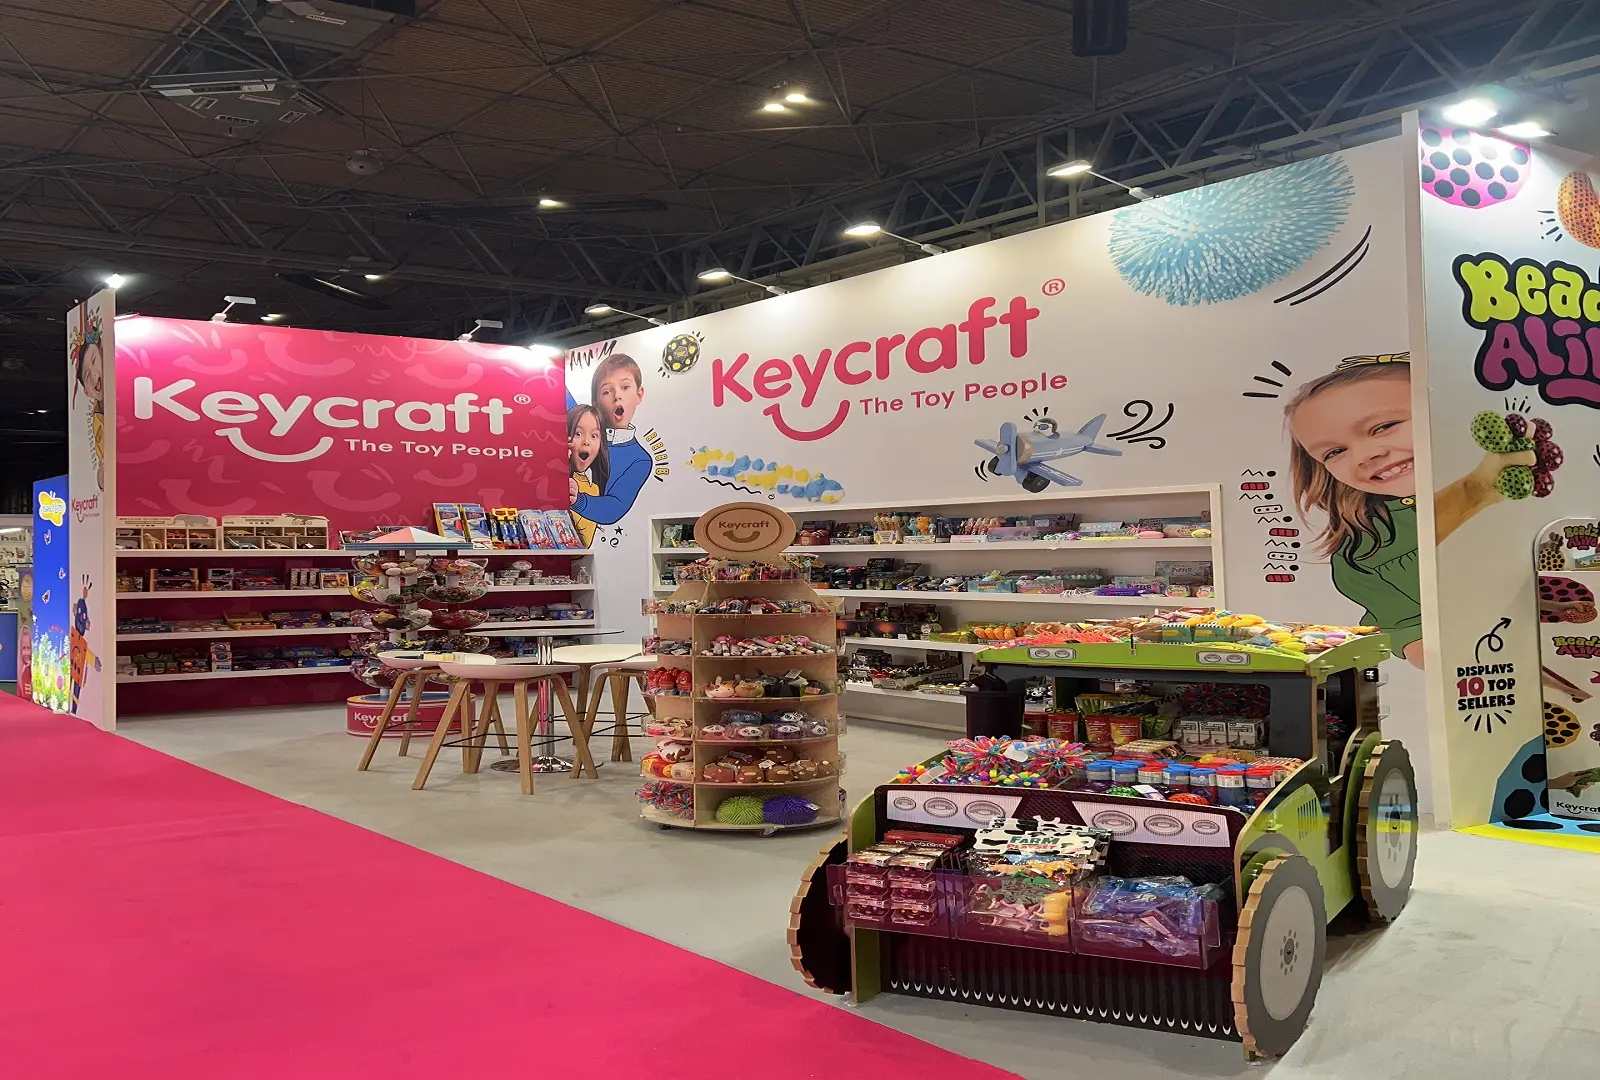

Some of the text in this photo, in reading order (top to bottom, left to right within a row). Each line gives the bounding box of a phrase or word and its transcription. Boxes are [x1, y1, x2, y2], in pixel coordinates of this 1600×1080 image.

[712, 296, 1040, 408] Keycraft
[860, 372, 1068, 415] The Toy People
[134, 376, 513, 437] Keycraft
[344, 438, 534, 460] The Toy People
[718, 520, 770, 530] Keycraft
[1457, 663, 1514, 677] DISPLAYS
[1456, 677, 1516, 697] 10 TOP
[1458, 694, 1516, 711] SELLERS
[1009, 836, 1060, 845] FARM
